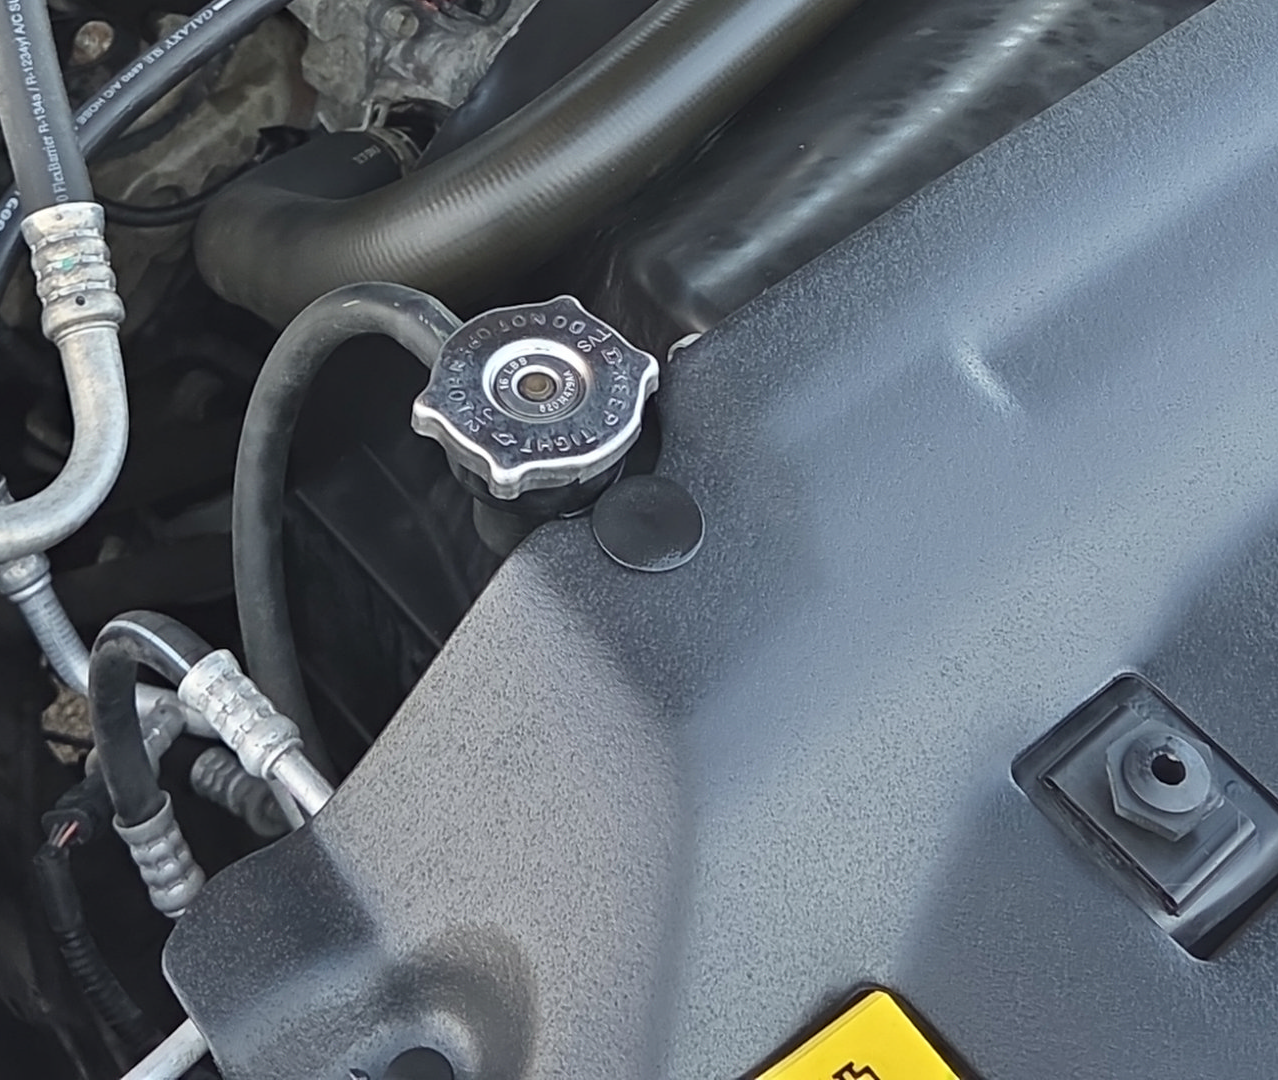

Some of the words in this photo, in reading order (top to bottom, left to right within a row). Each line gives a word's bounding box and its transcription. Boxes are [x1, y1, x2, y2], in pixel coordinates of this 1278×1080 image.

[11, 14, 27, 35] A/C
[164, 9, 214, 50] GALAXY
[15, 37, 37, 85] R-1234yf
[103, 81, 122, 100] A/C
[31, 93, 50, 134] R-134a
[76, 98, 106, 126] HOSE
[42, 136, 66, 194] FlexBarrier
[499, 312, 547, 333] NOT
[553, 315, 586, 335] DO
[577, 328, 613, 353] TVS
[499, 377, 509, 390] 16
[604, 370, 631, 426] KEEP
[464, 407, 494, 432] J12
[520, 429, 597, 453] TIGHT
